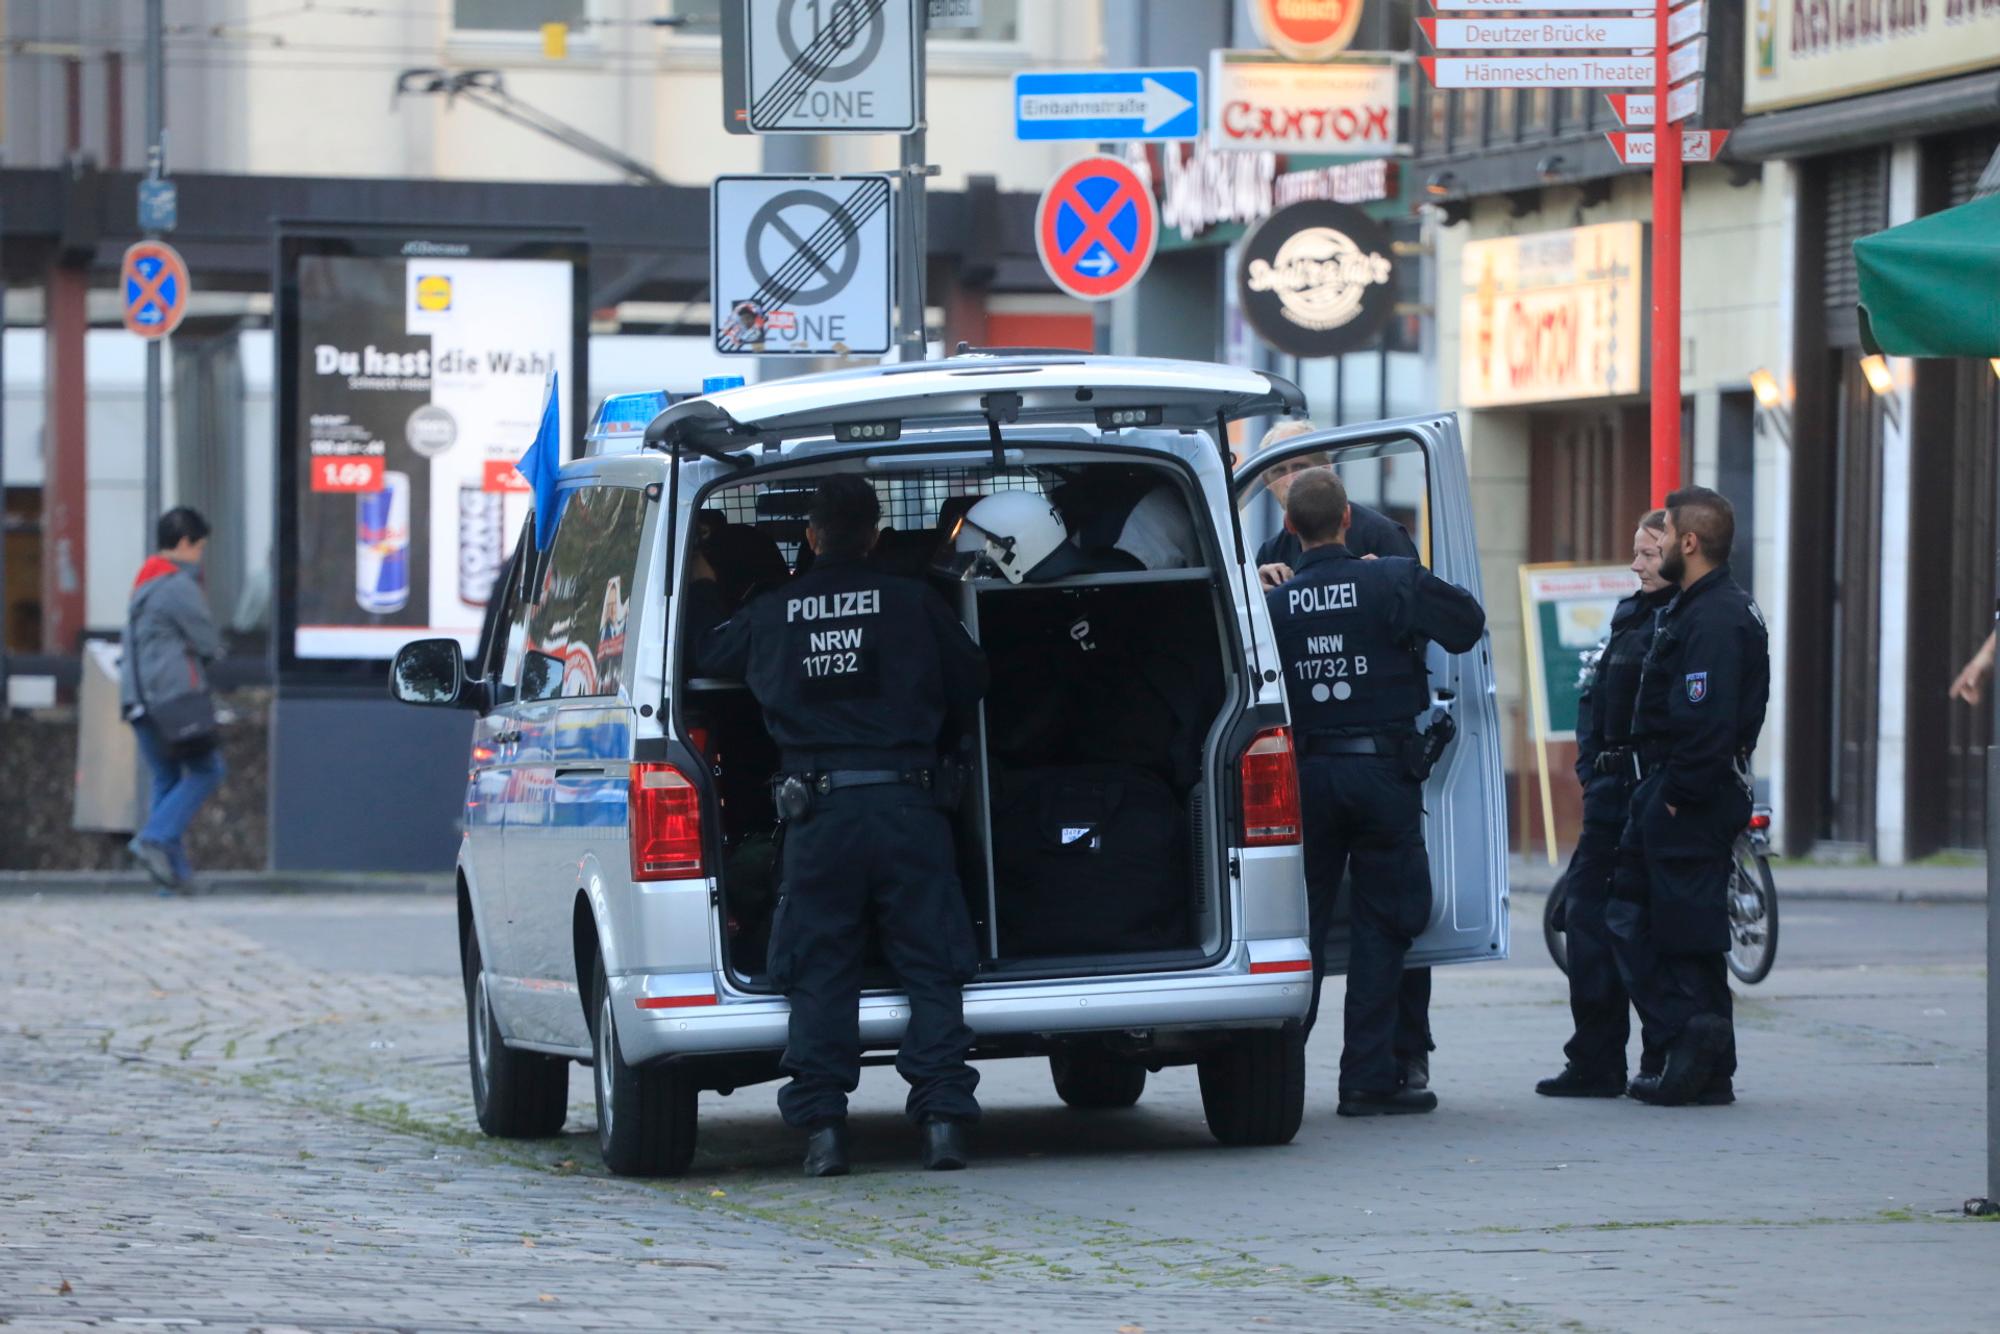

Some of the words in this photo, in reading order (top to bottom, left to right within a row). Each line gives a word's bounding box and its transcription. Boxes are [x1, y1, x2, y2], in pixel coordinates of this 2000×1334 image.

[1466, 25, 1539, 42] Deutzer
[1543, 25, 1606, 42] Brücke
[1465, 64, 1579, 81] Hänneschen
[1582, 63, 1652, 81] Theater
[792, 91, 874, 118] ZONE
[1024, 98, 1148, 116] Einbahnstraße
[1629, 106, 1654, 115] TAXI
[1629, 142, 1652, 154] WC
[764, 316, 846, 341] ONE
[315, 345, 360, 375] Du
[364, 345, 431, 376] hast
[438, 350, 478, 374] die
[488, 350, 555, 375] Wahl
[787, 589, 880, 623] POLIZEI
[1289, 583, 1358, 615] POLIZEI
[810, 627, 863, 652] NRW
[1307, 634, 1343, 655] NRW
[803, 652, 858, 677] 11732
[1295, 658, 1348, 680] 11732
[1354, 656, 1369, 675] B
